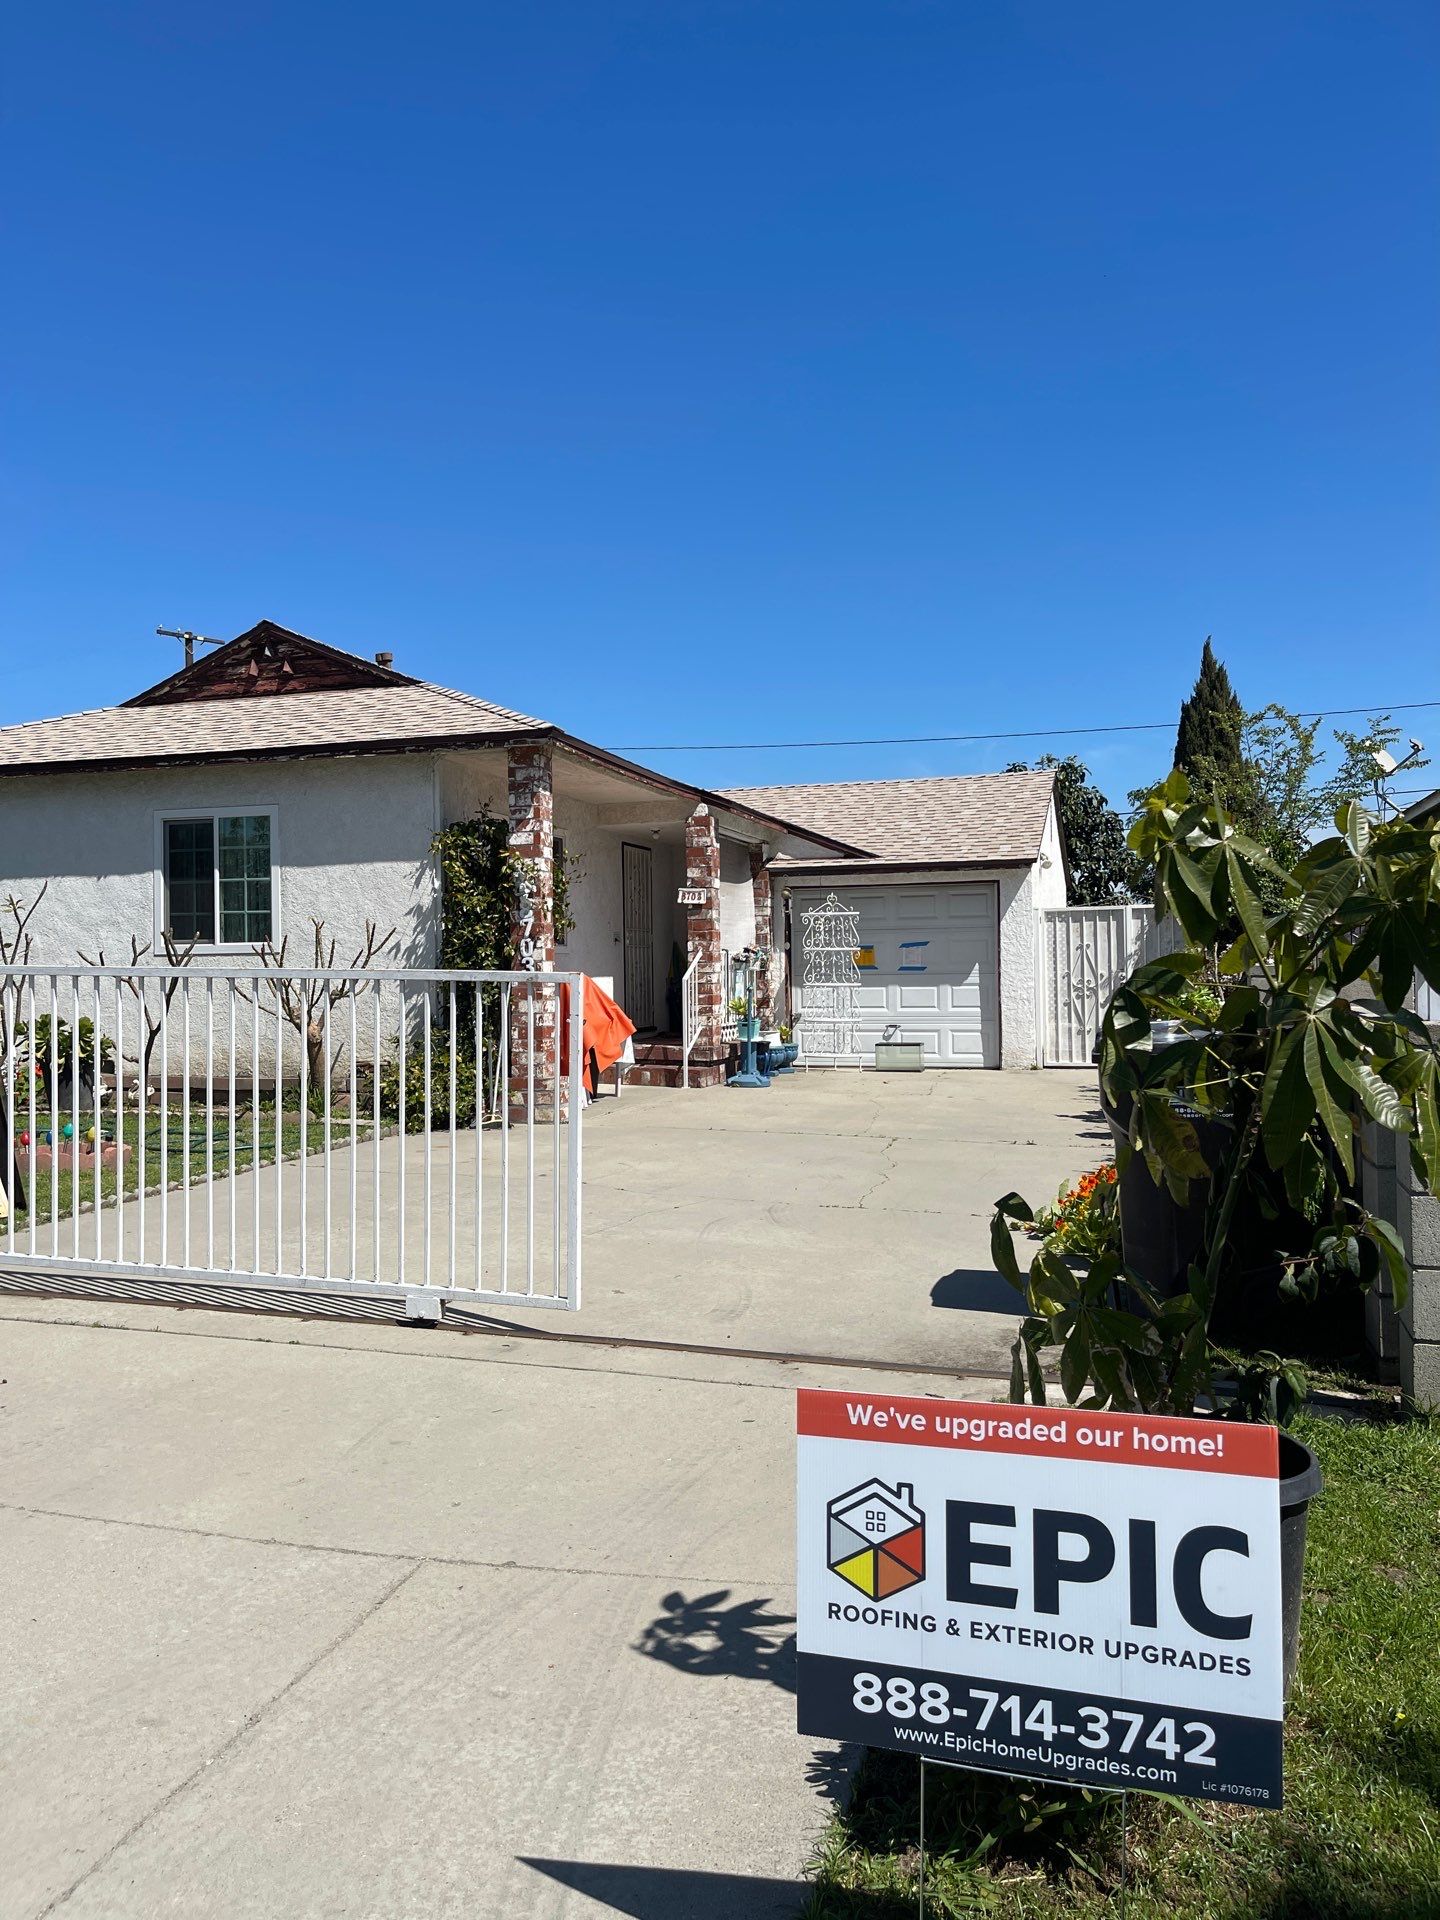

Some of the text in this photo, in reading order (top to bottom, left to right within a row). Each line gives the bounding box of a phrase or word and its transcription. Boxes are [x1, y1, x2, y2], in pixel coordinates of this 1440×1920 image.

[846, 1403, 1224, 1458] We've upgraded our home!
[945, 1499, 1253, 1641] EPIC
[828, 1602, 1252, 1677] ROOFING & EXTERIOR UPGRADES
[852, 1672, 1217, 1767] 888-714-3742
[893, 1726, 1177, 1783] www.EpicHomeUpgrades.com
[1202, 1780, 1270, 1799] Lic #1076178
